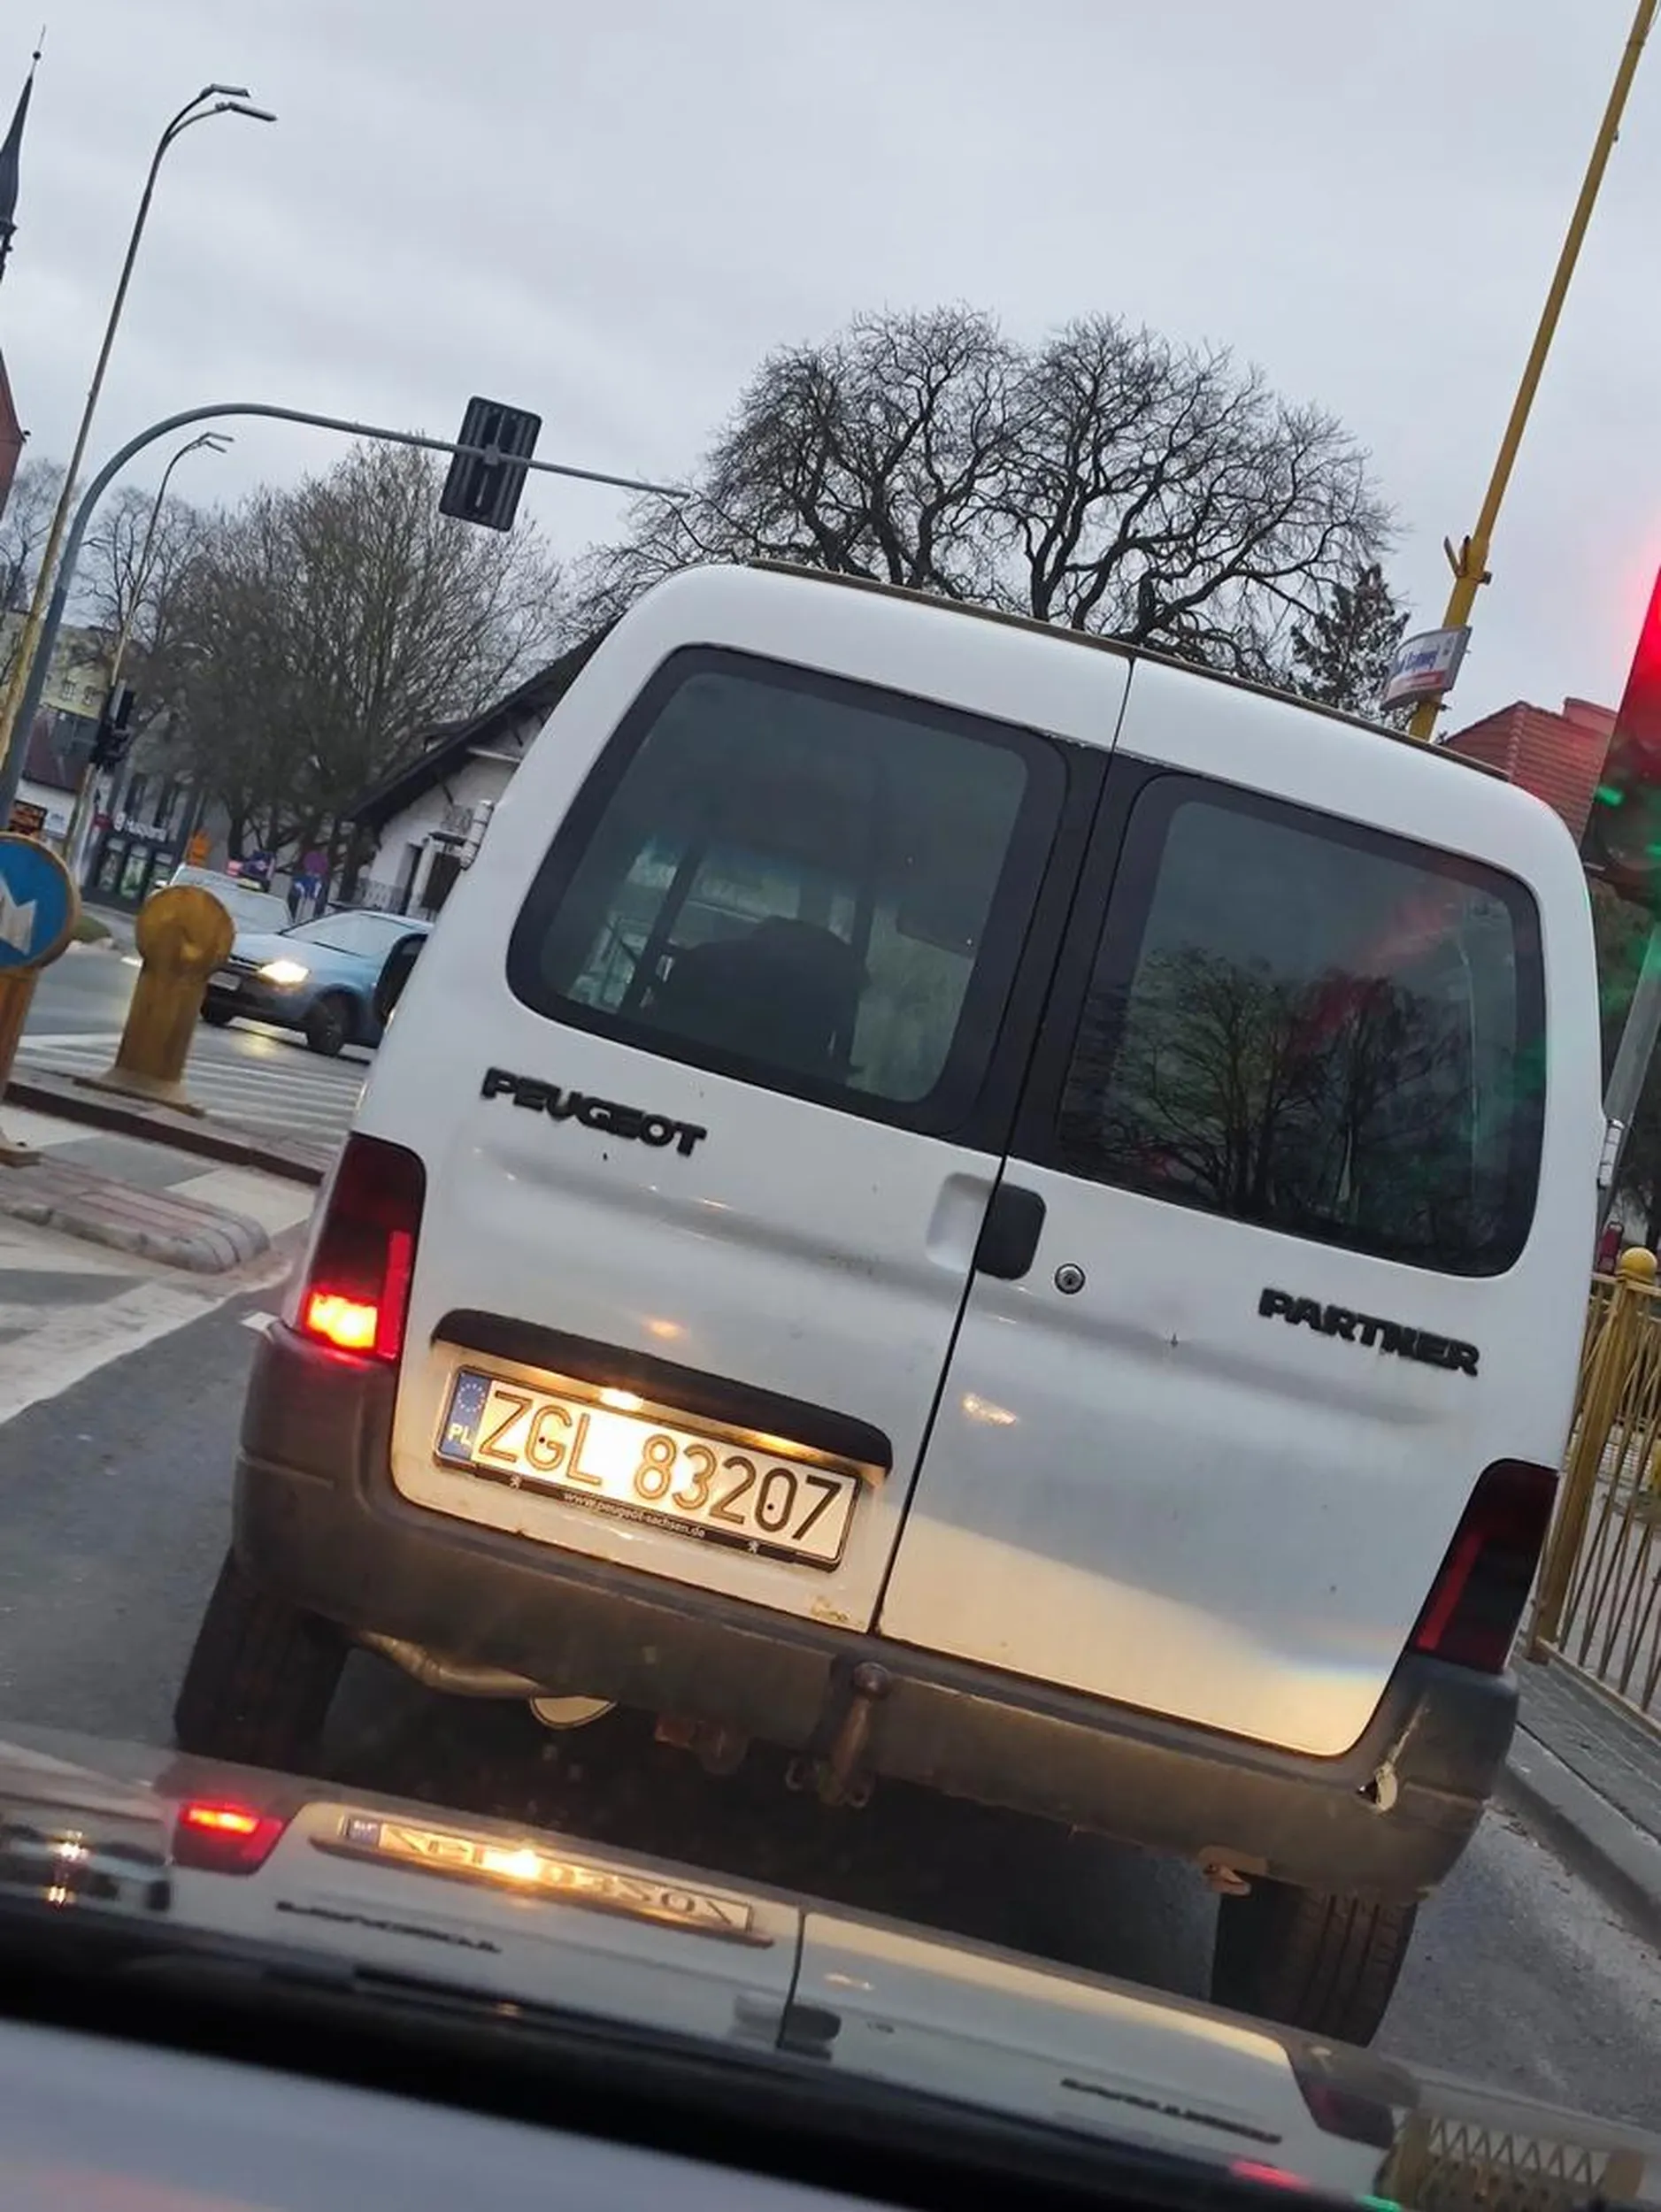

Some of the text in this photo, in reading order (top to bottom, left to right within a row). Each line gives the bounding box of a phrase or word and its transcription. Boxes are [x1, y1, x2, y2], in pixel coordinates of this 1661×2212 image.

[481, 1067, 707, 1156] PEUGEOT
[1258, 1288, 1480, 1377] PARTNER
[448, 1423, 472, 1447] PL
[479, 1391, 842, 1540] ZGL 83207
